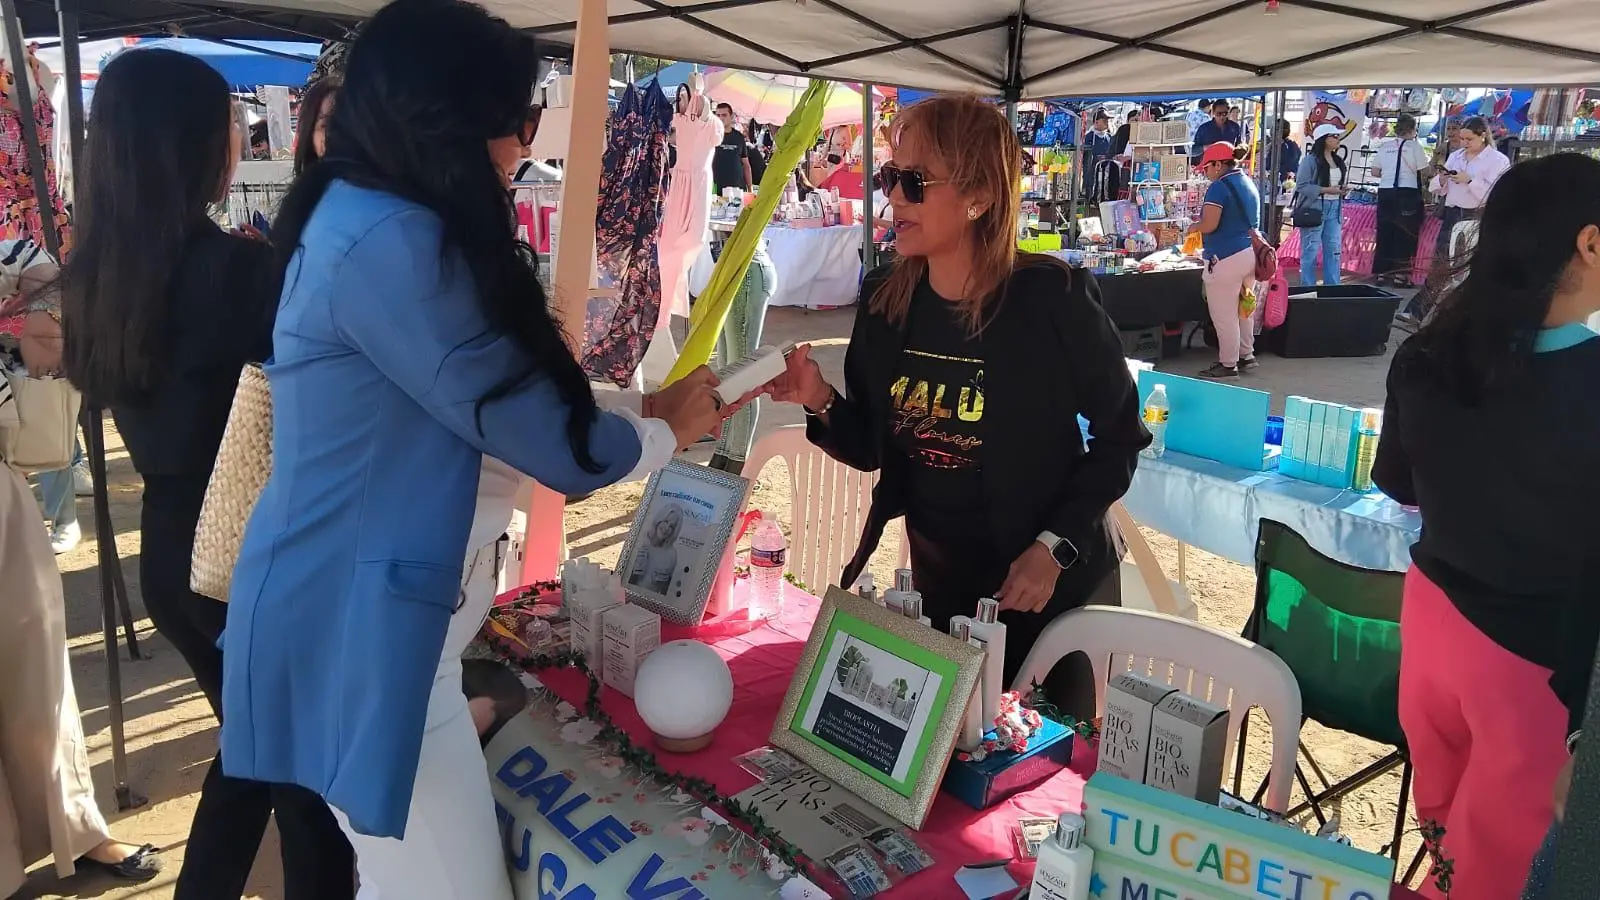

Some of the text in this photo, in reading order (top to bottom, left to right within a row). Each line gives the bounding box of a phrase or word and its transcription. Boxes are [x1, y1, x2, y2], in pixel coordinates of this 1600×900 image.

[1106, 713, 1132, 734] BIO
[1105, 728, 1139, 753] PLAS
[1155, 737, 1181, 759] BIO
[1105, 743, 1126, 764] TIA
[1154, 752, 1190, 777] PLAS
[788, 768, 832, 793] BIO
[1153, 767, 1176, 789] TIA
[752, 787, 789, 812] TIA
[769, 777, 826, 811] PLAS
[496, 746, 705, 900] DALE V
[1101, 808, 1160, 857] TU
